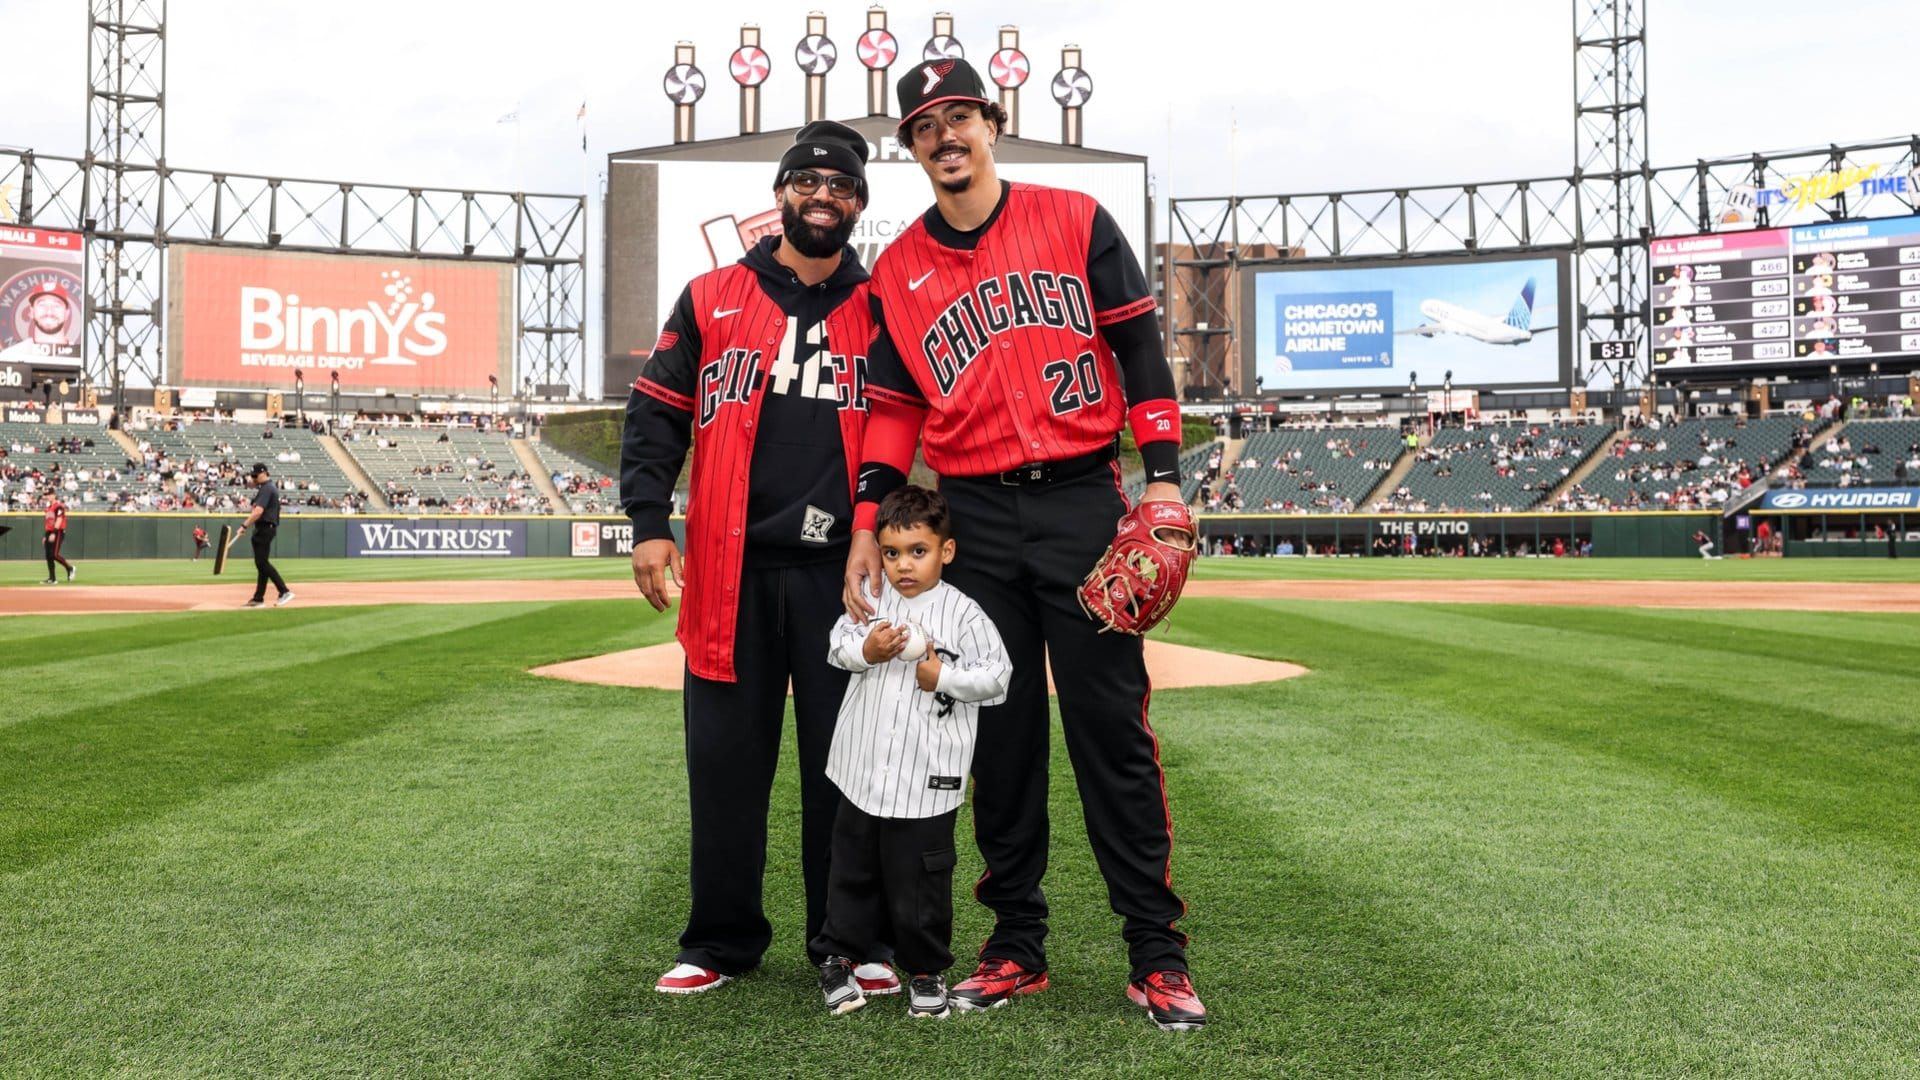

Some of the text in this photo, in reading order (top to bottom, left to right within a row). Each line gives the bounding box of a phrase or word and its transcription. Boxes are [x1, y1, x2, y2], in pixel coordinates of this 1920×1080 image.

[1861, 176, 1907, 195] TIME
[1284, 303, 1377, 320] CHICAGO'S
[922, 270, 1095, 397] CHICAGO
[1284, 319, 1384, 337] HOMETOWN
[1284, 336, 1347, 353] AIRLINE
[241, 352, 366, 370] BEVERAGE DEPOT
[1342, 355, 1373, 364] UNITED
[1043, 350, 1104, 416] 20
[9, 411, 41, 423] Modelo
[67, 412, 98, 424] Modelo
[1156, 419, 1171, 431] 20
[1030, 470, 1042, 480] 20
[1810, 492, 1912, 507] HYUNDAI
[1380, 521, 1470, 535] THE PATIO
